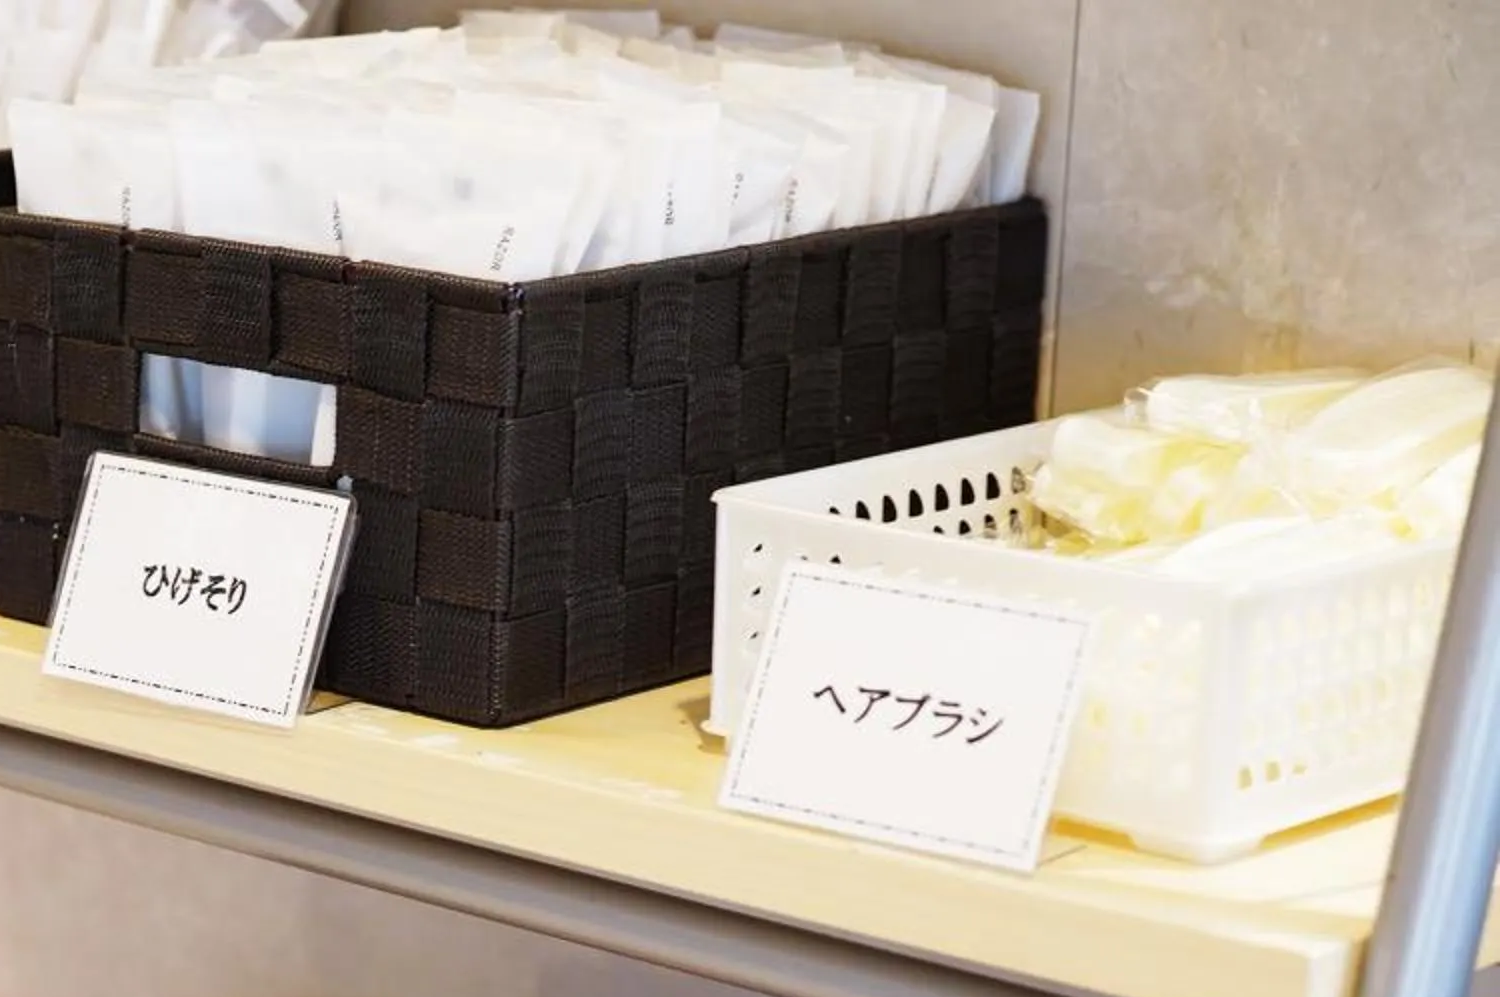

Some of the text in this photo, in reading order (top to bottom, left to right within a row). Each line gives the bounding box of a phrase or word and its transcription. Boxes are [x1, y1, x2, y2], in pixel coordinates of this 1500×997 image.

[142, 564, 247, 614] ひげそり
[813, 685, 1003, 744] ヘアブラシ
